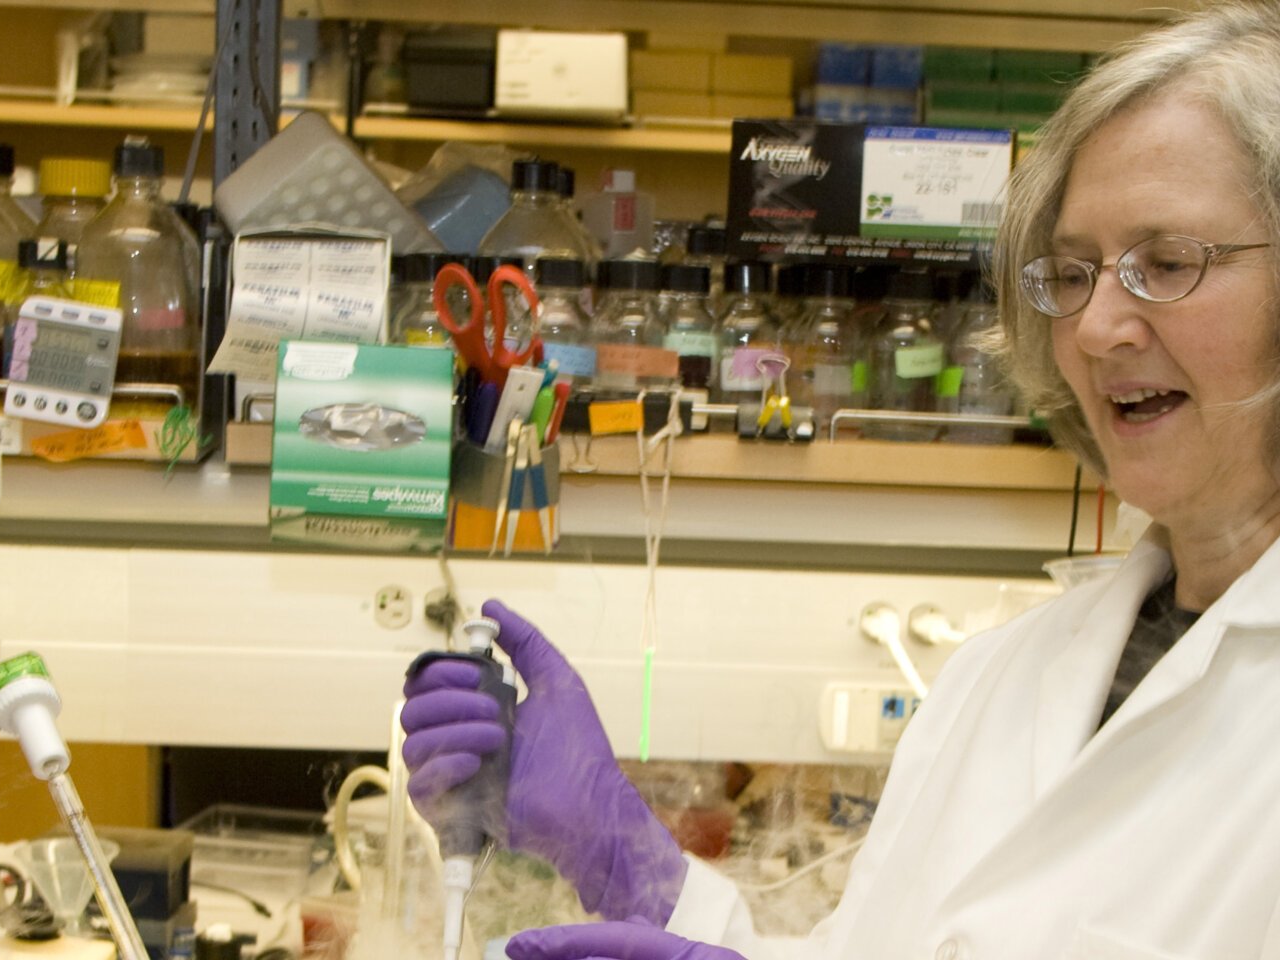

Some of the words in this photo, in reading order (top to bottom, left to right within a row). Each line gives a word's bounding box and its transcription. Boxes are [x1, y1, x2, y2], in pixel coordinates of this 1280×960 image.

[740, 138, 811, 161] AXYGEN
[769, 158, 831, 181] Quality
[371, 484, 446, 508] Kimwipes
